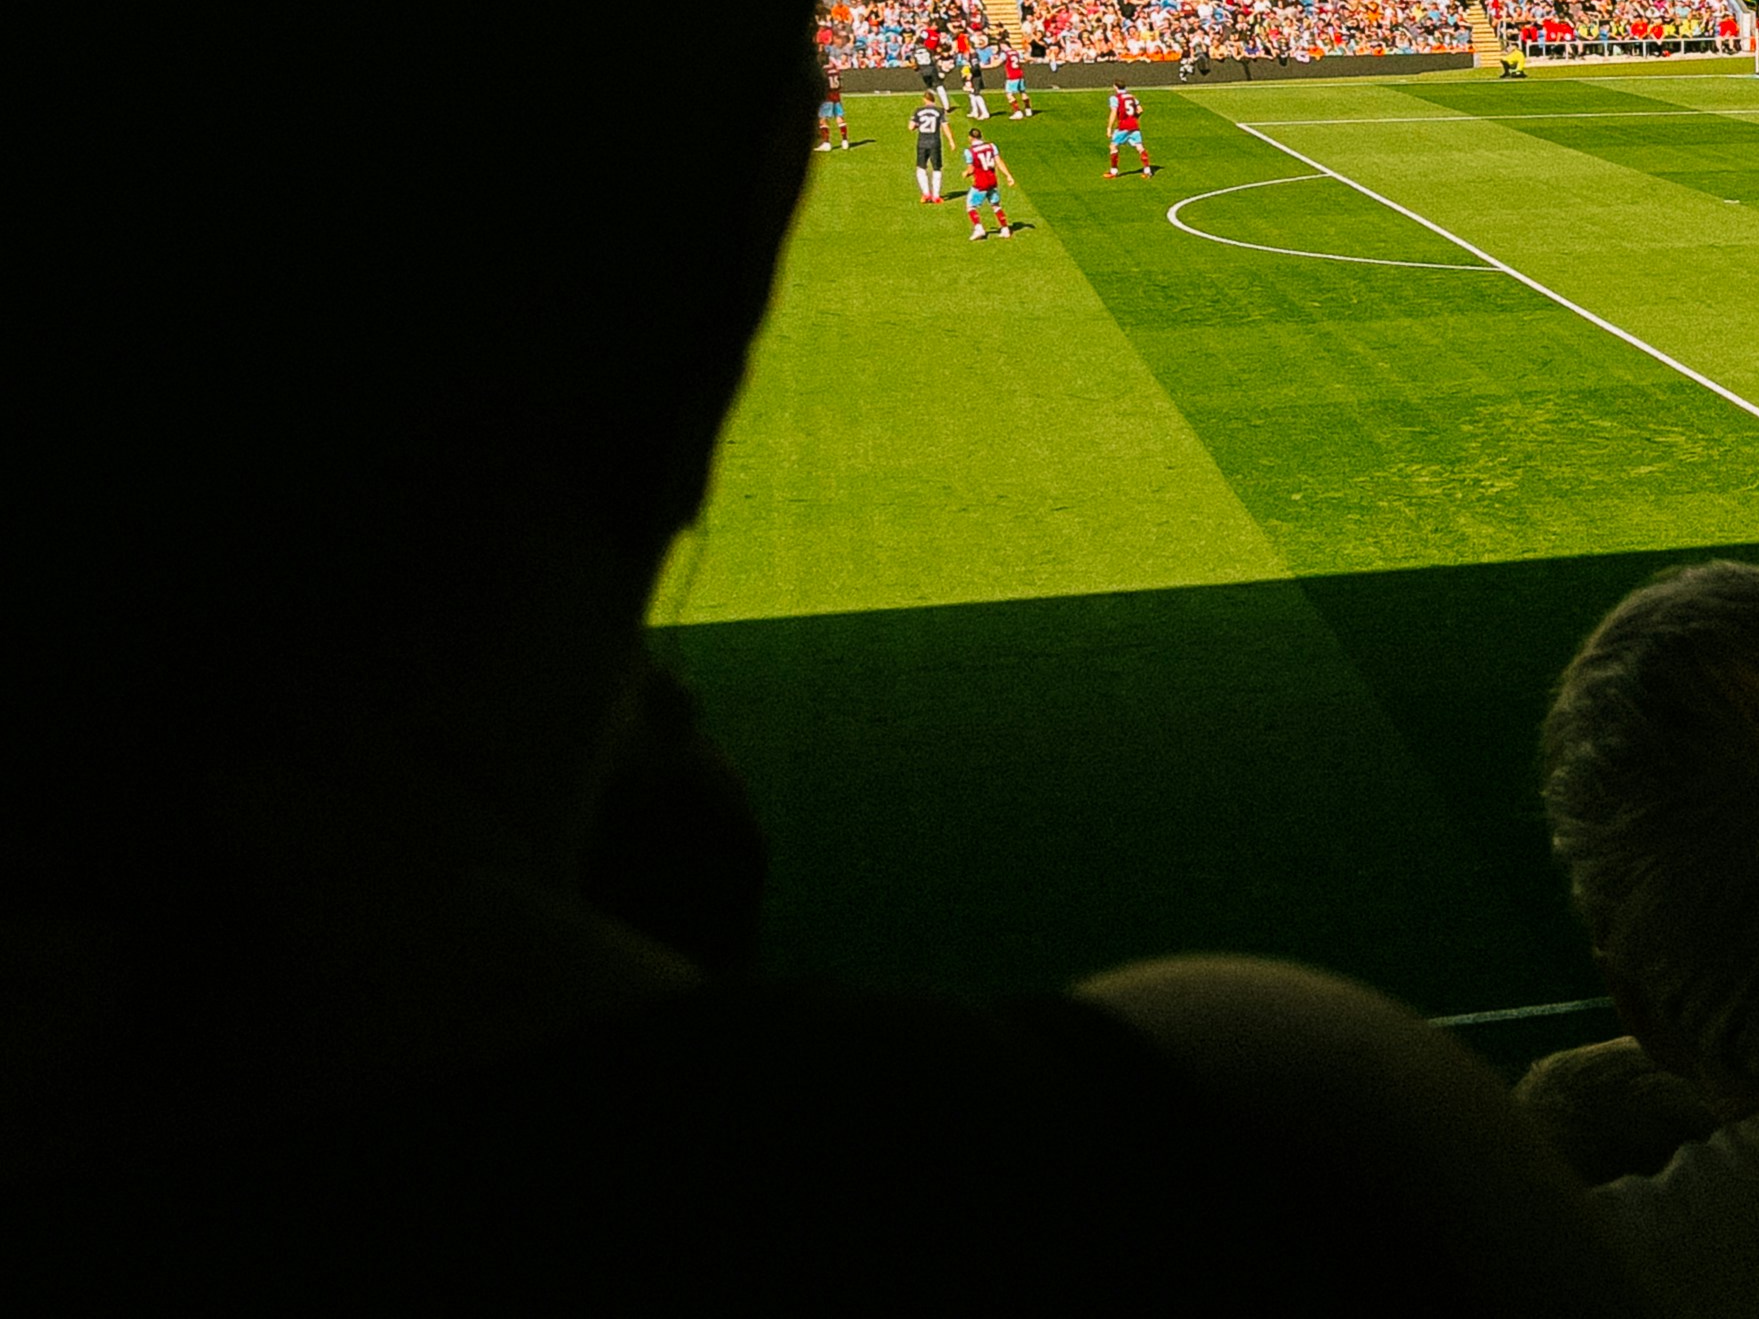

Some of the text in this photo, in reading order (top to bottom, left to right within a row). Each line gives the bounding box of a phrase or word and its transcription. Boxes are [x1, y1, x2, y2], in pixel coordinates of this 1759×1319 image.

[1124, 99, 1135, 116] 5
[919, 116, 937, 133] 21
[977, 151, 995, 171] 14
